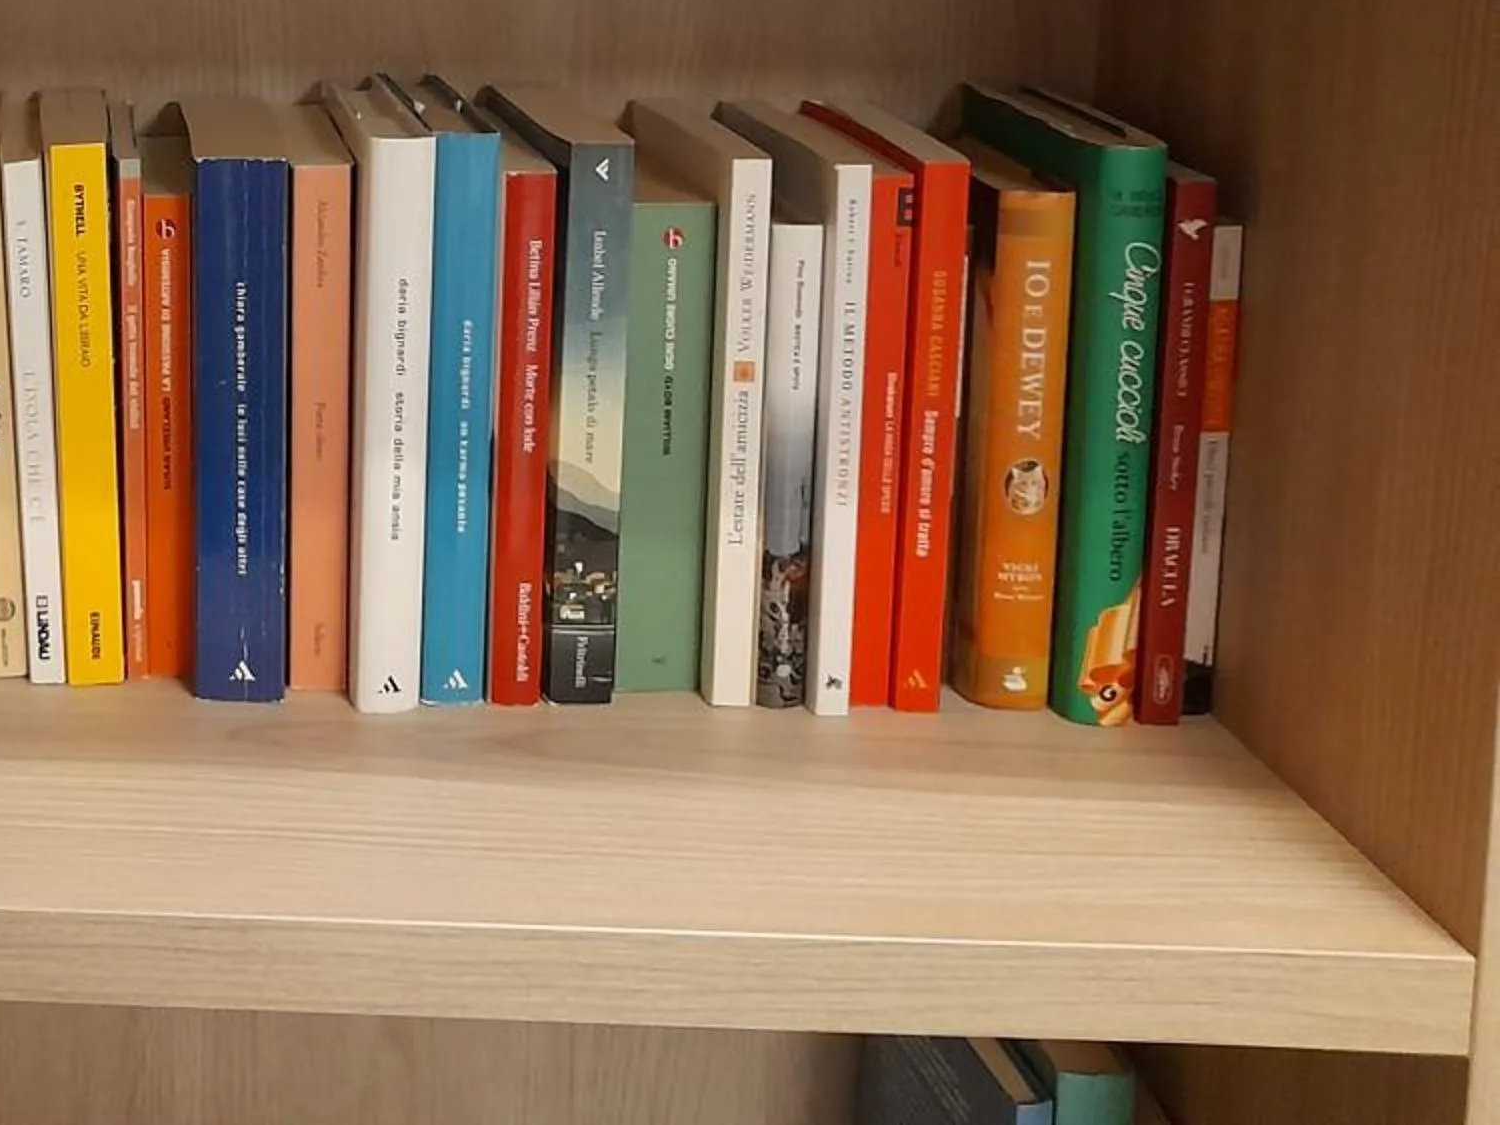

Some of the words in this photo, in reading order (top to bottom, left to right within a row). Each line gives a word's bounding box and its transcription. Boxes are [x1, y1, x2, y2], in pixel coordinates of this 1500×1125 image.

[73, 184, 86, 238] BYTHELL
[77, 250, 88, 277] UNA
[593, 230, 607, 268] Isabel
[77, 279, 89, 306] VITA
[397, 278, 409, 314] daria
[590, 271, 605, 321] Allende
[1025, 261, 1051, 298] IO
[1108, 242, 1161, 331] Cinque
[236, 281, 247, 321] chiara
[845, 302, 857, 315] IL
[1023, 305, 1043, 318] E
[234, 326, 247, 392] gamberale
[394, 321, 408, 377] bignardi
[841, 325, 856, 391] METODO
[586, 374, 600, 413] petalo
[1016, 329, 1047, 440] DEWEY
[1115, 340, 1147, 444] cuccioli
[237, 419, 248, 442] luci
[394, 391, 405, 432] storia
[587, 415, 599, 428] di
[585, 431, 595, 464] mare
[730, 390, 749, 486] dell'amicizia
[922, 410, 940, 455] Sempre
[237, 447, 248, 477] nelle
[393, 438, 405, 470] della
[836, 399, 852, 507] ANTISTRONZI
[237, 480, 246, 508] case
[392, 476, 401, 501] mia
[918, 458, 936, 505] d'amore
[1113, 452, 1130, 503] sotto
[236, 513, 248, 543] degli
[390, 506, 400, 541] ansia
[728, 489, 744, 545] L'estate
[916, 507, 932, 521] si
[915, 523, 931, 557] tratta
[1109, 509, 1133, 582] l'albero
[237, 546, 248, 574] altri
[1161, 527, 1182, 607] DRACULA
[89, 611, 101, 660] EINAUDI
